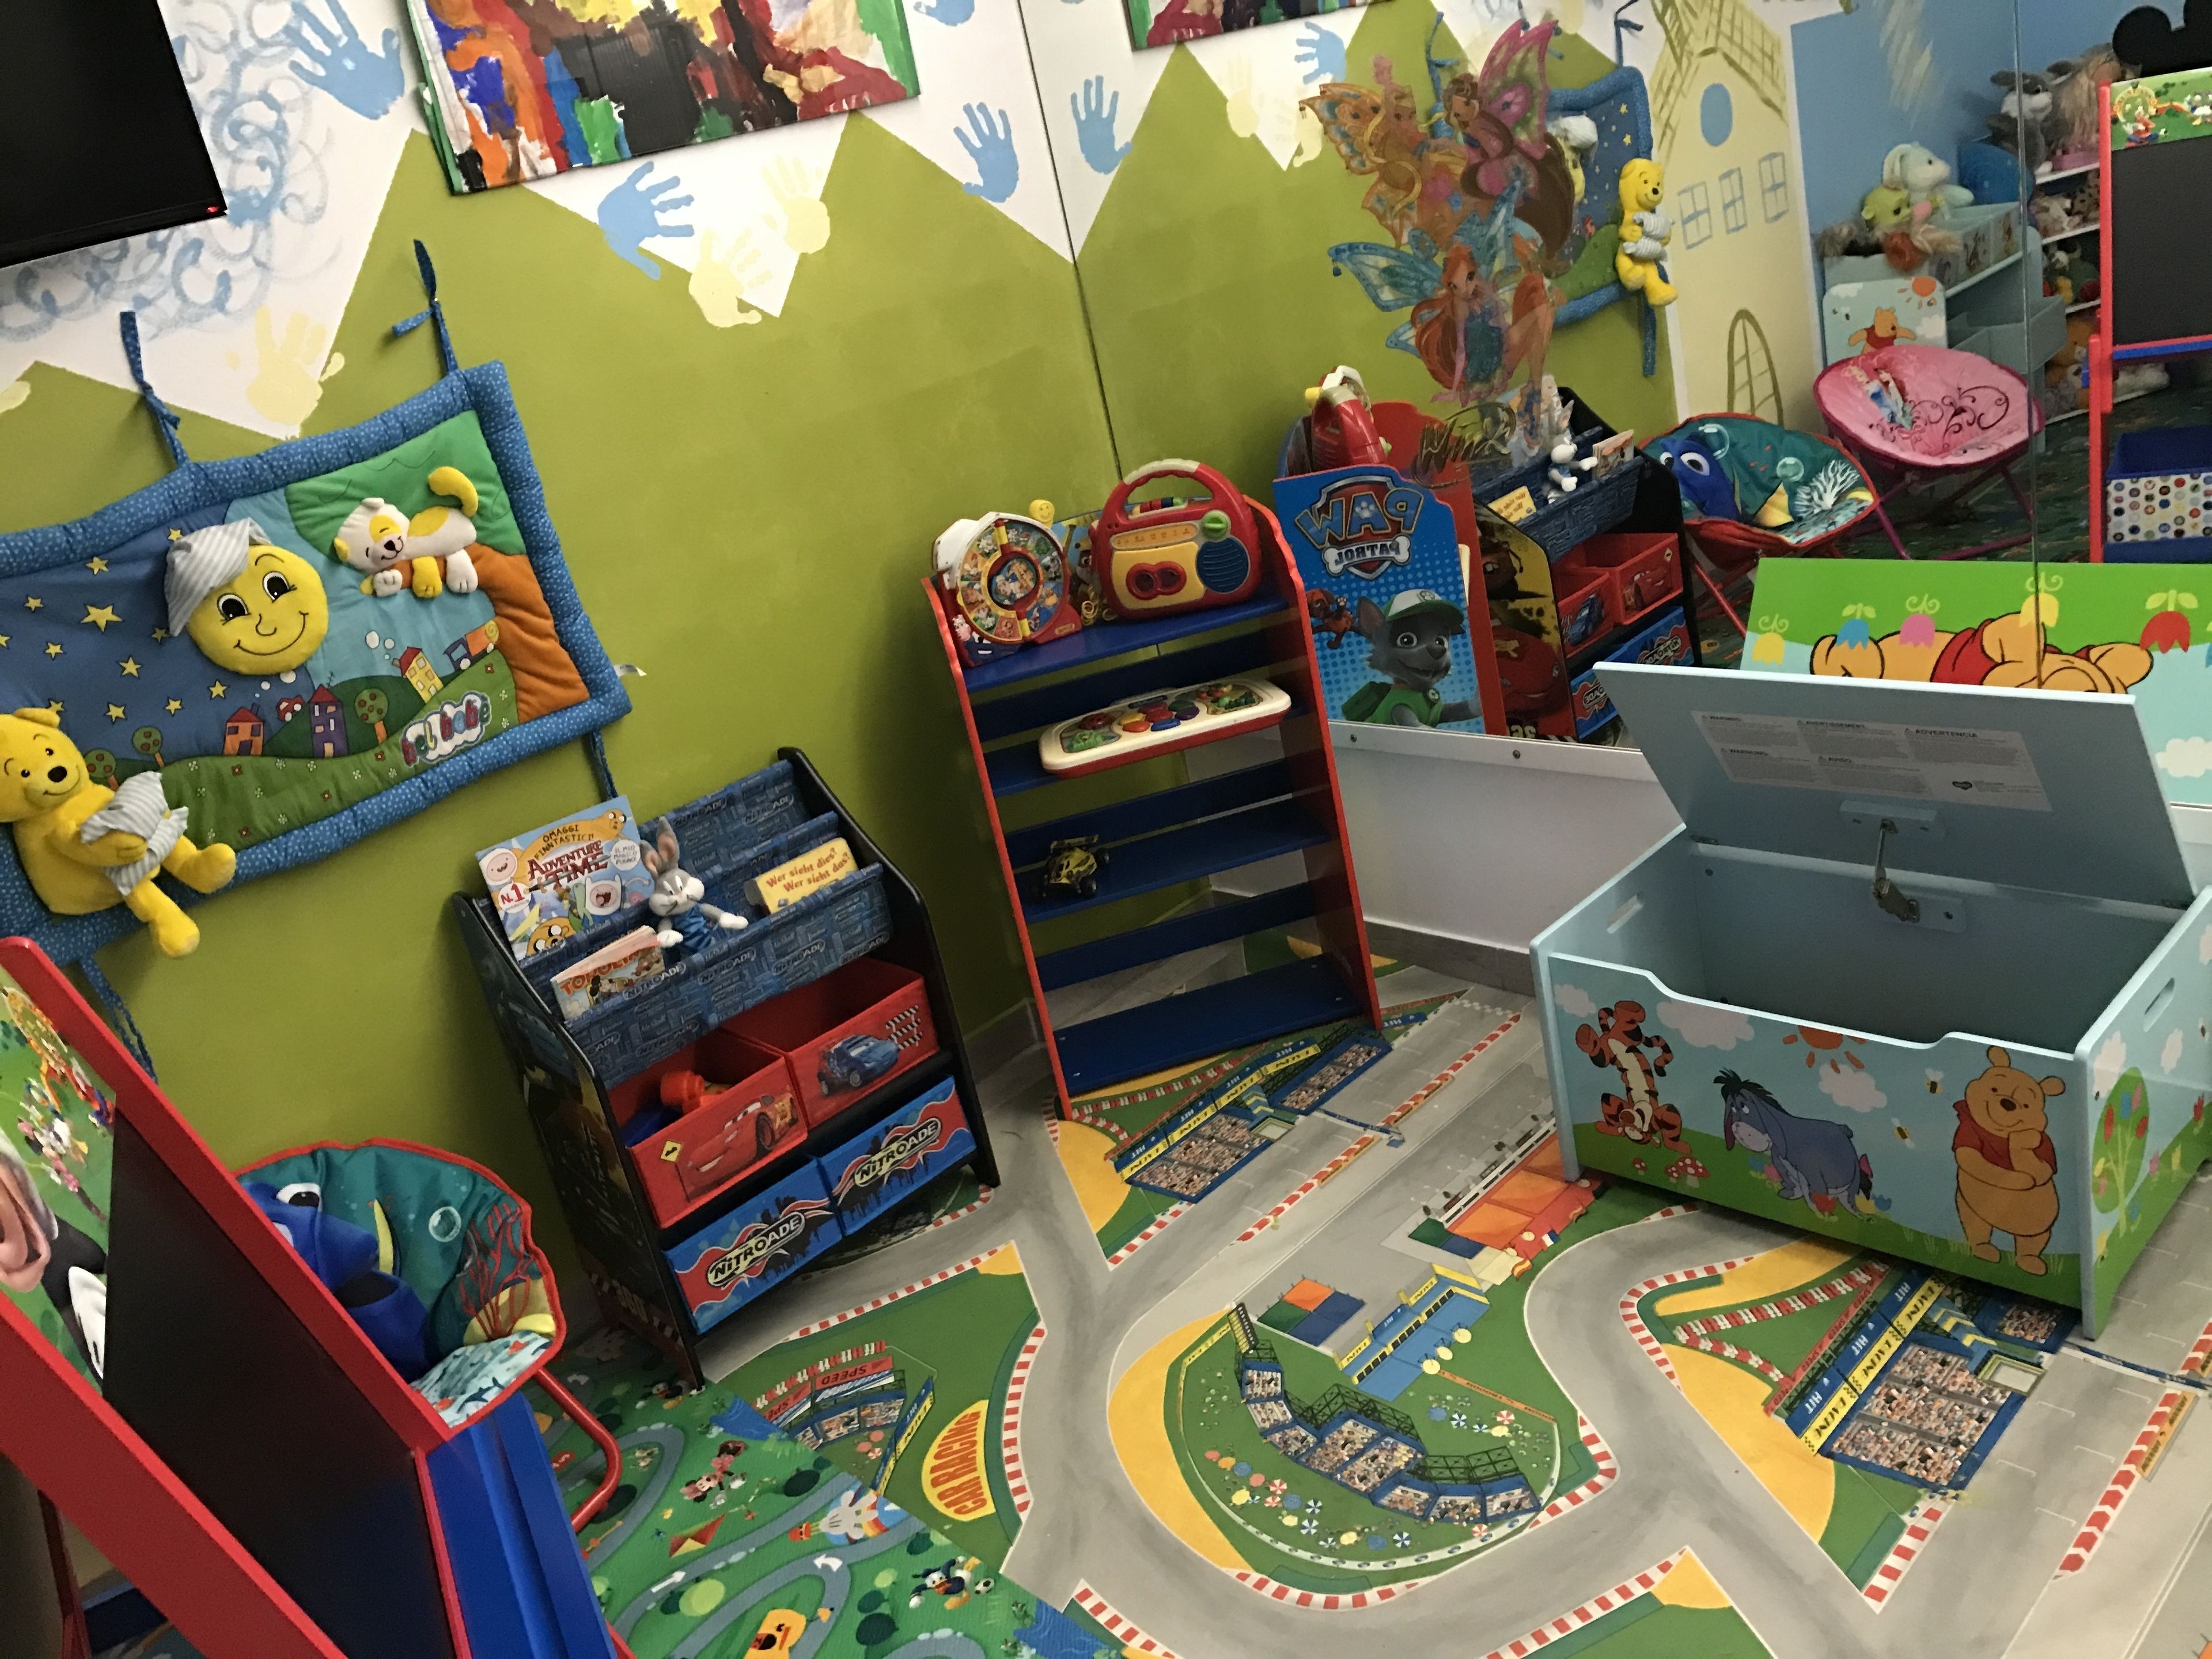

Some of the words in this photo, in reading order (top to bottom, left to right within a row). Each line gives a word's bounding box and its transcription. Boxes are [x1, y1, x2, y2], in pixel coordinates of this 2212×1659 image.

[1915, 729, 1978, 738] ADVERTENCIA
[543, 824, 579, 843] OMAGGI
[527, 839, 603, 881] ADVENTURE
[544, 853, 609, 888] TIME
[766, 872, 786, 887] Wer
[789, 864, 814, 877] sieht
[816, 847, 838, 869] dies?
[783, 879, 804, 892] Wer
[807, 870, 831, 885] sieht
[832, 851, 851, 873] das?
[859, 1123, 937, 1178] NITROADE
[713, 1217, 801, 1279] NITROADE
[1895, 1282, 1911, 1302] HIT
[1851, 1334, 1869, 1356] HIT
[821, 1364, 867, 1385] SPEED
[1804, 1391, 1823, 1414] HIT
[929, 1410, 982, 1489] RACING
[937, 1475, 987, 1515] CAR
